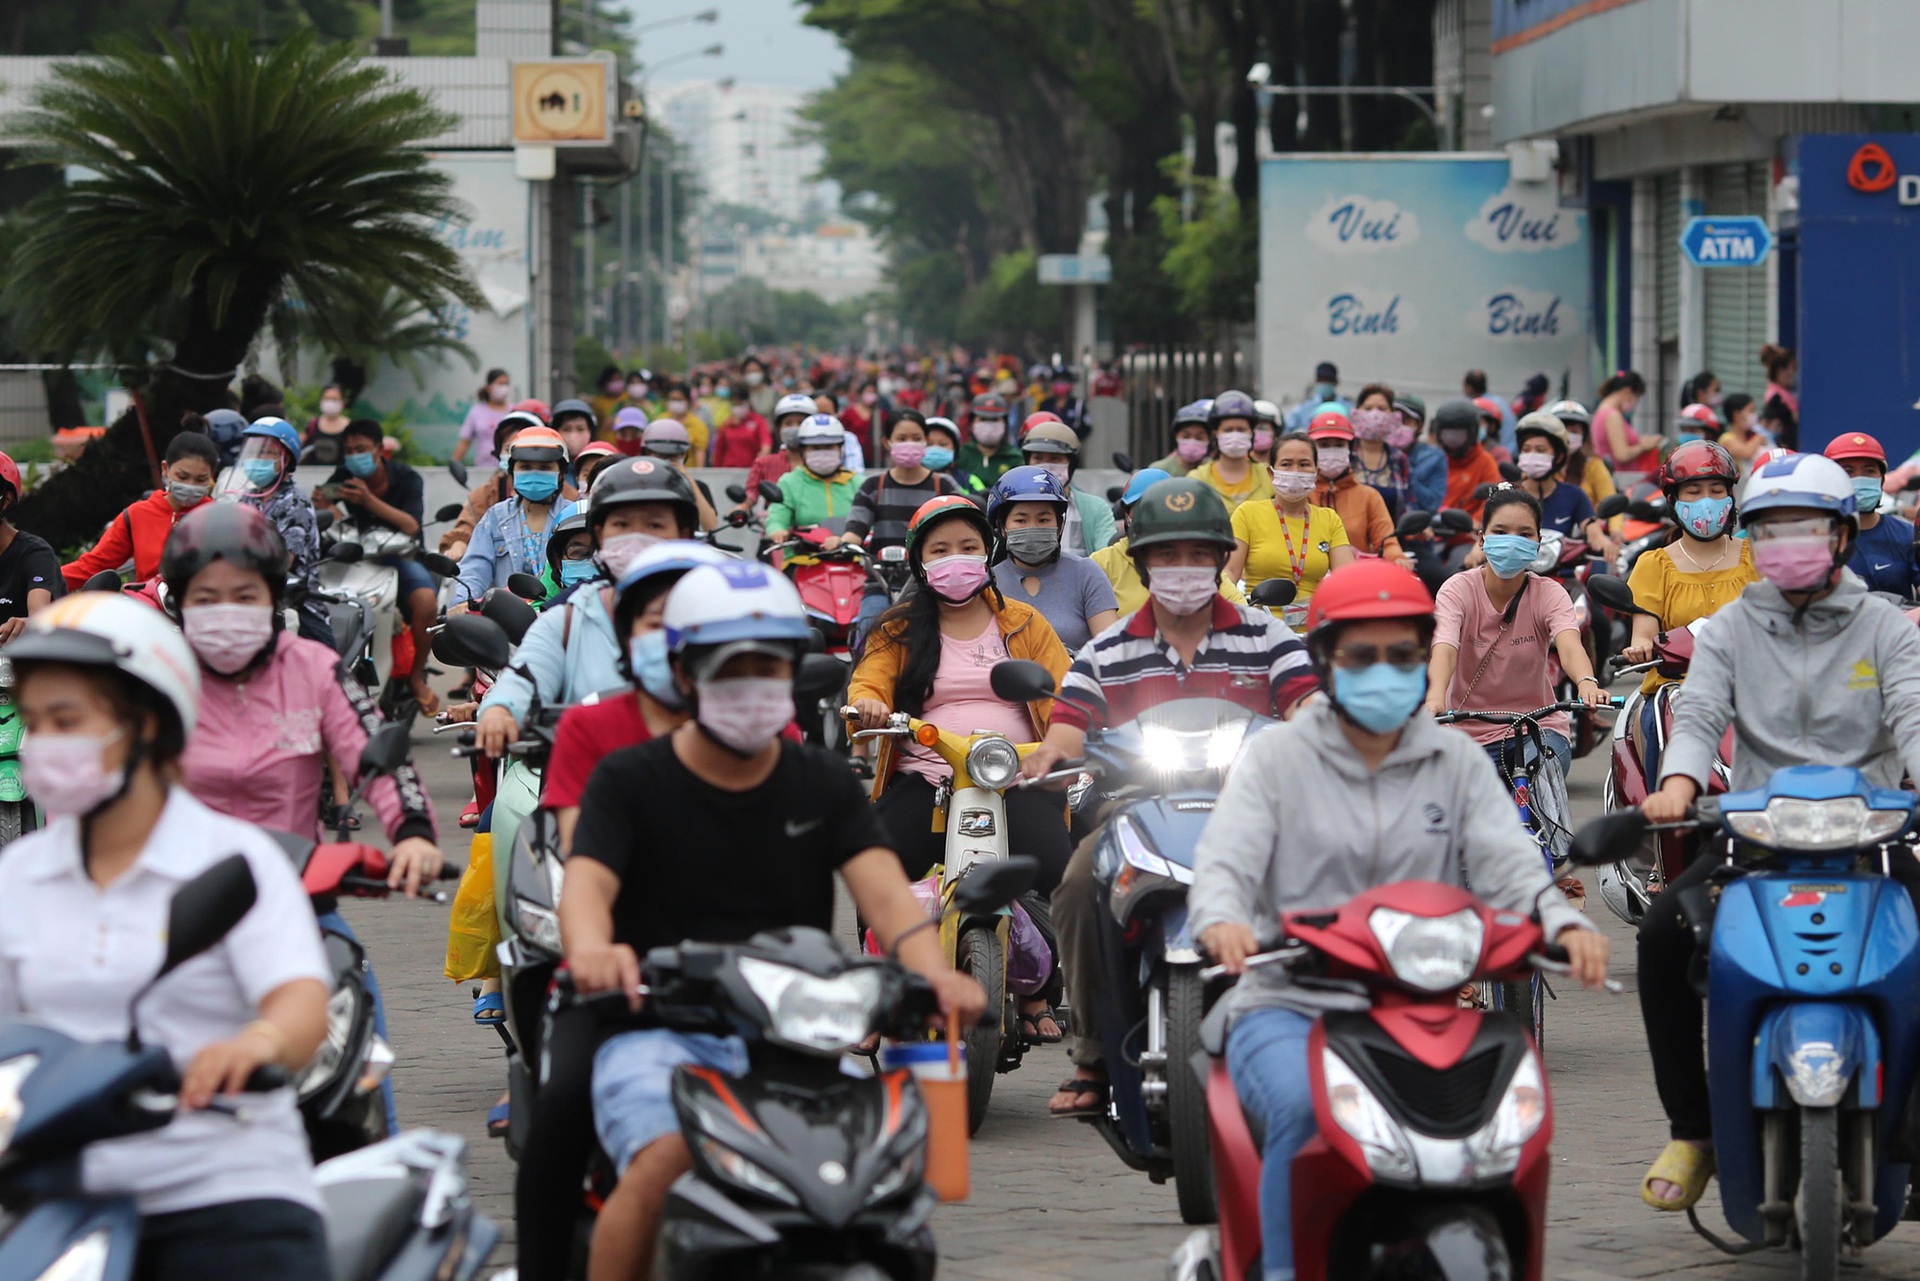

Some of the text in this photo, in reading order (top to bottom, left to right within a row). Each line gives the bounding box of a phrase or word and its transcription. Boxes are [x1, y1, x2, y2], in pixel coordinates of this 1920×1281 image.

[1329, 203, 1401, 242] Vui
[1489, 203, 1560, 242] Vui
[1699, 236, 1755, 260] ATM
[1509, 635, 1536, 647] OBTAIN
